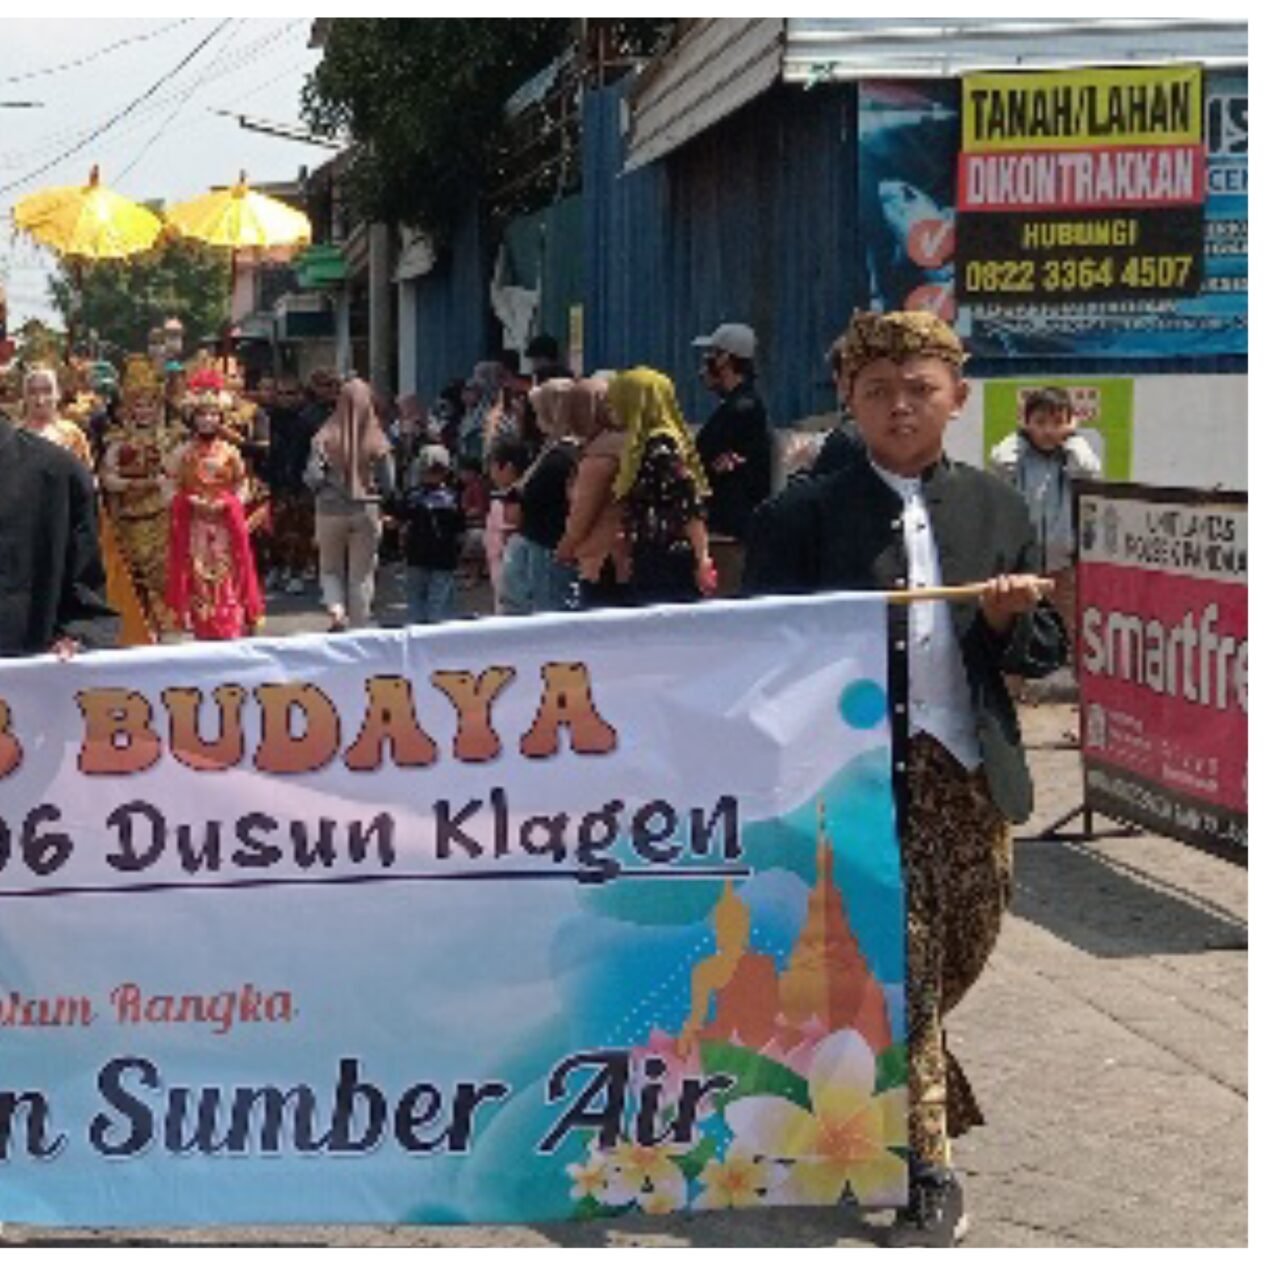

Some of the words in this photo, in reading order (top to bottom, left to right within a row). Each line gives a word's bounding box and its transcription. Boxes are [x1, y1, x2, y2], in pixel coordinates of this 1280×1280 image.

[970, 81, 1191, 141] TANAH/LAHAN
[965, 148, 1195, 205] DIKONTRAKKAN
[1022, 219, 1140, 249] HUBUNGI
[965, 258, 1036, 293] 0822
[1041, 255, 1114, 291] 3364
[1120, 254, 1193, 289] 4507
[73, 660, 619, 775] BUDAYA
[104, 798, 398, 874] Dusun
[432, 786, 743, 885] Klagen
[109, 982, 300, 1036] Rangka
[87, 1053, 511, 1158] Sumber
[535, 1048, 738, 1158] Air
